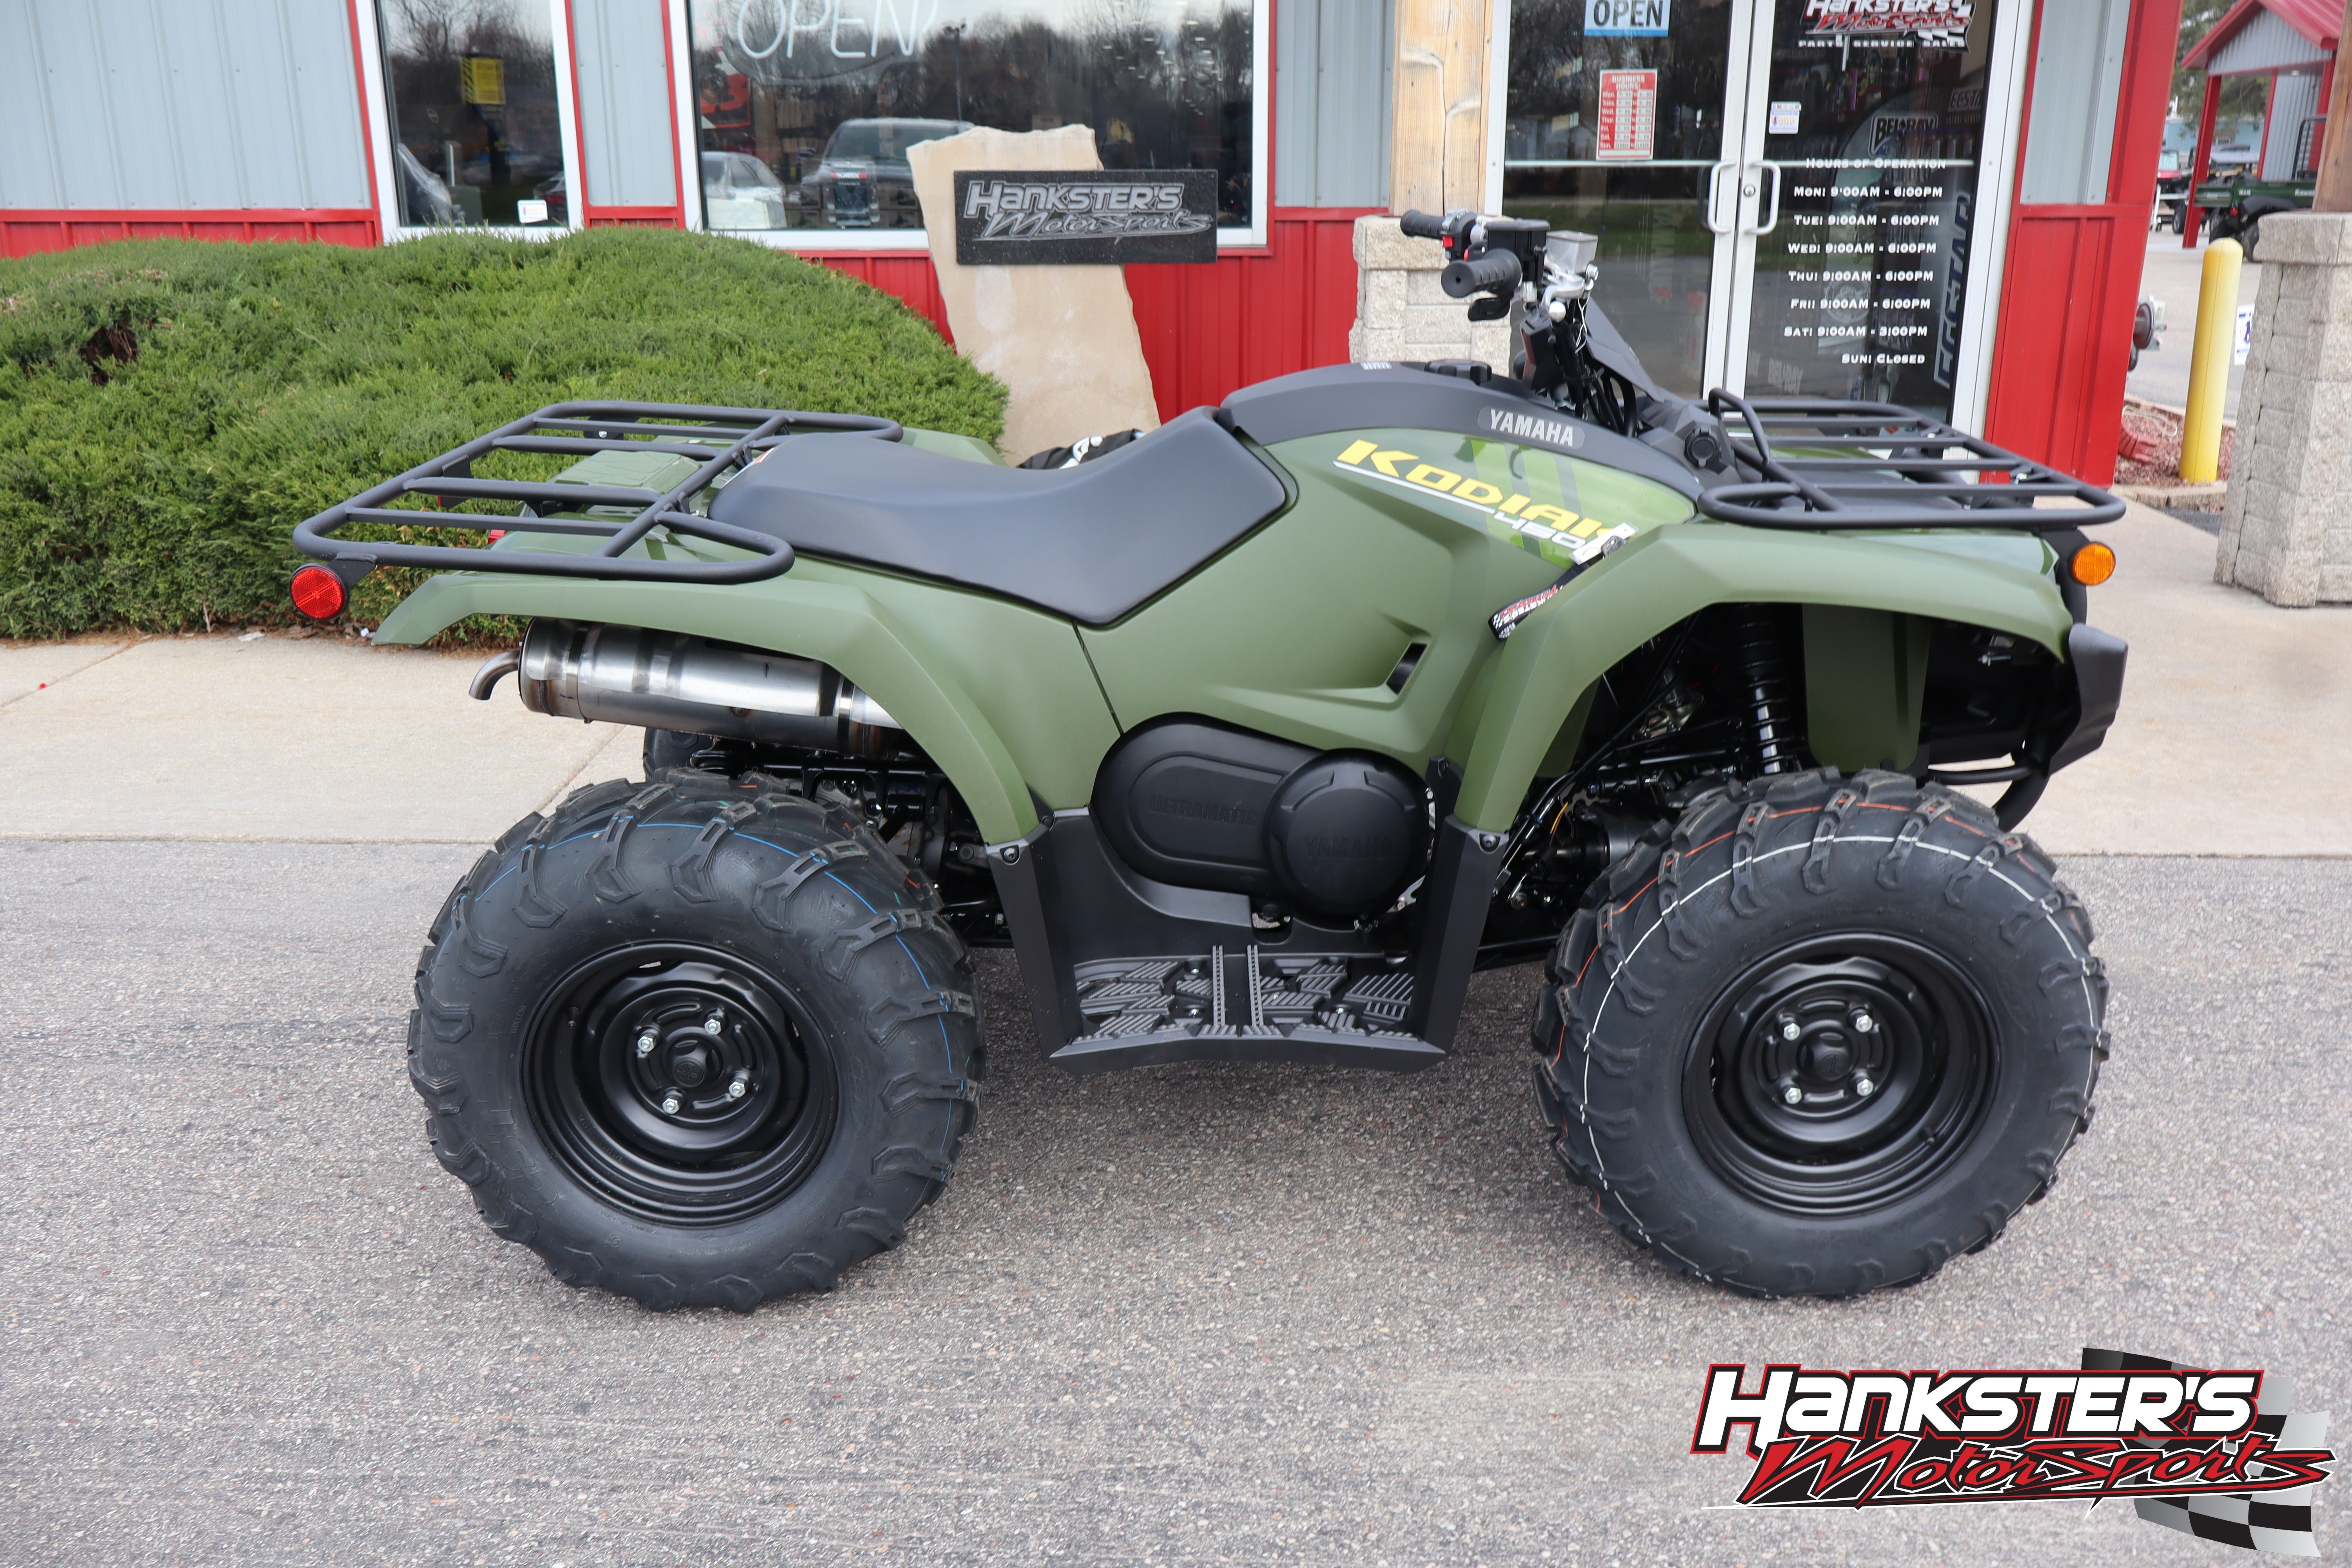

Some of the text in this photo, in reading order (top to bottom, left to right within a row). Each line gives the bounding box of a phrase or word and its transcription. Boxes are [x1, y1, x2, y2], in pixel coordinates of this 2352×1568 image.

[1593, 0, 1663, 27] OPEN
[737, 0, 919, 59] OPEN
[1612, 74, 1645, 83] BUSINESS
[1877, 354, 1925, 364] CLOSED
[1491, 409, 1574, 448] YAMAHA
[1494, 510, 1586, 549] 450
[1149, 795, 1258, 826] ULTRAMATIC
[1303, 836, 1394, 860] YAMAHA
